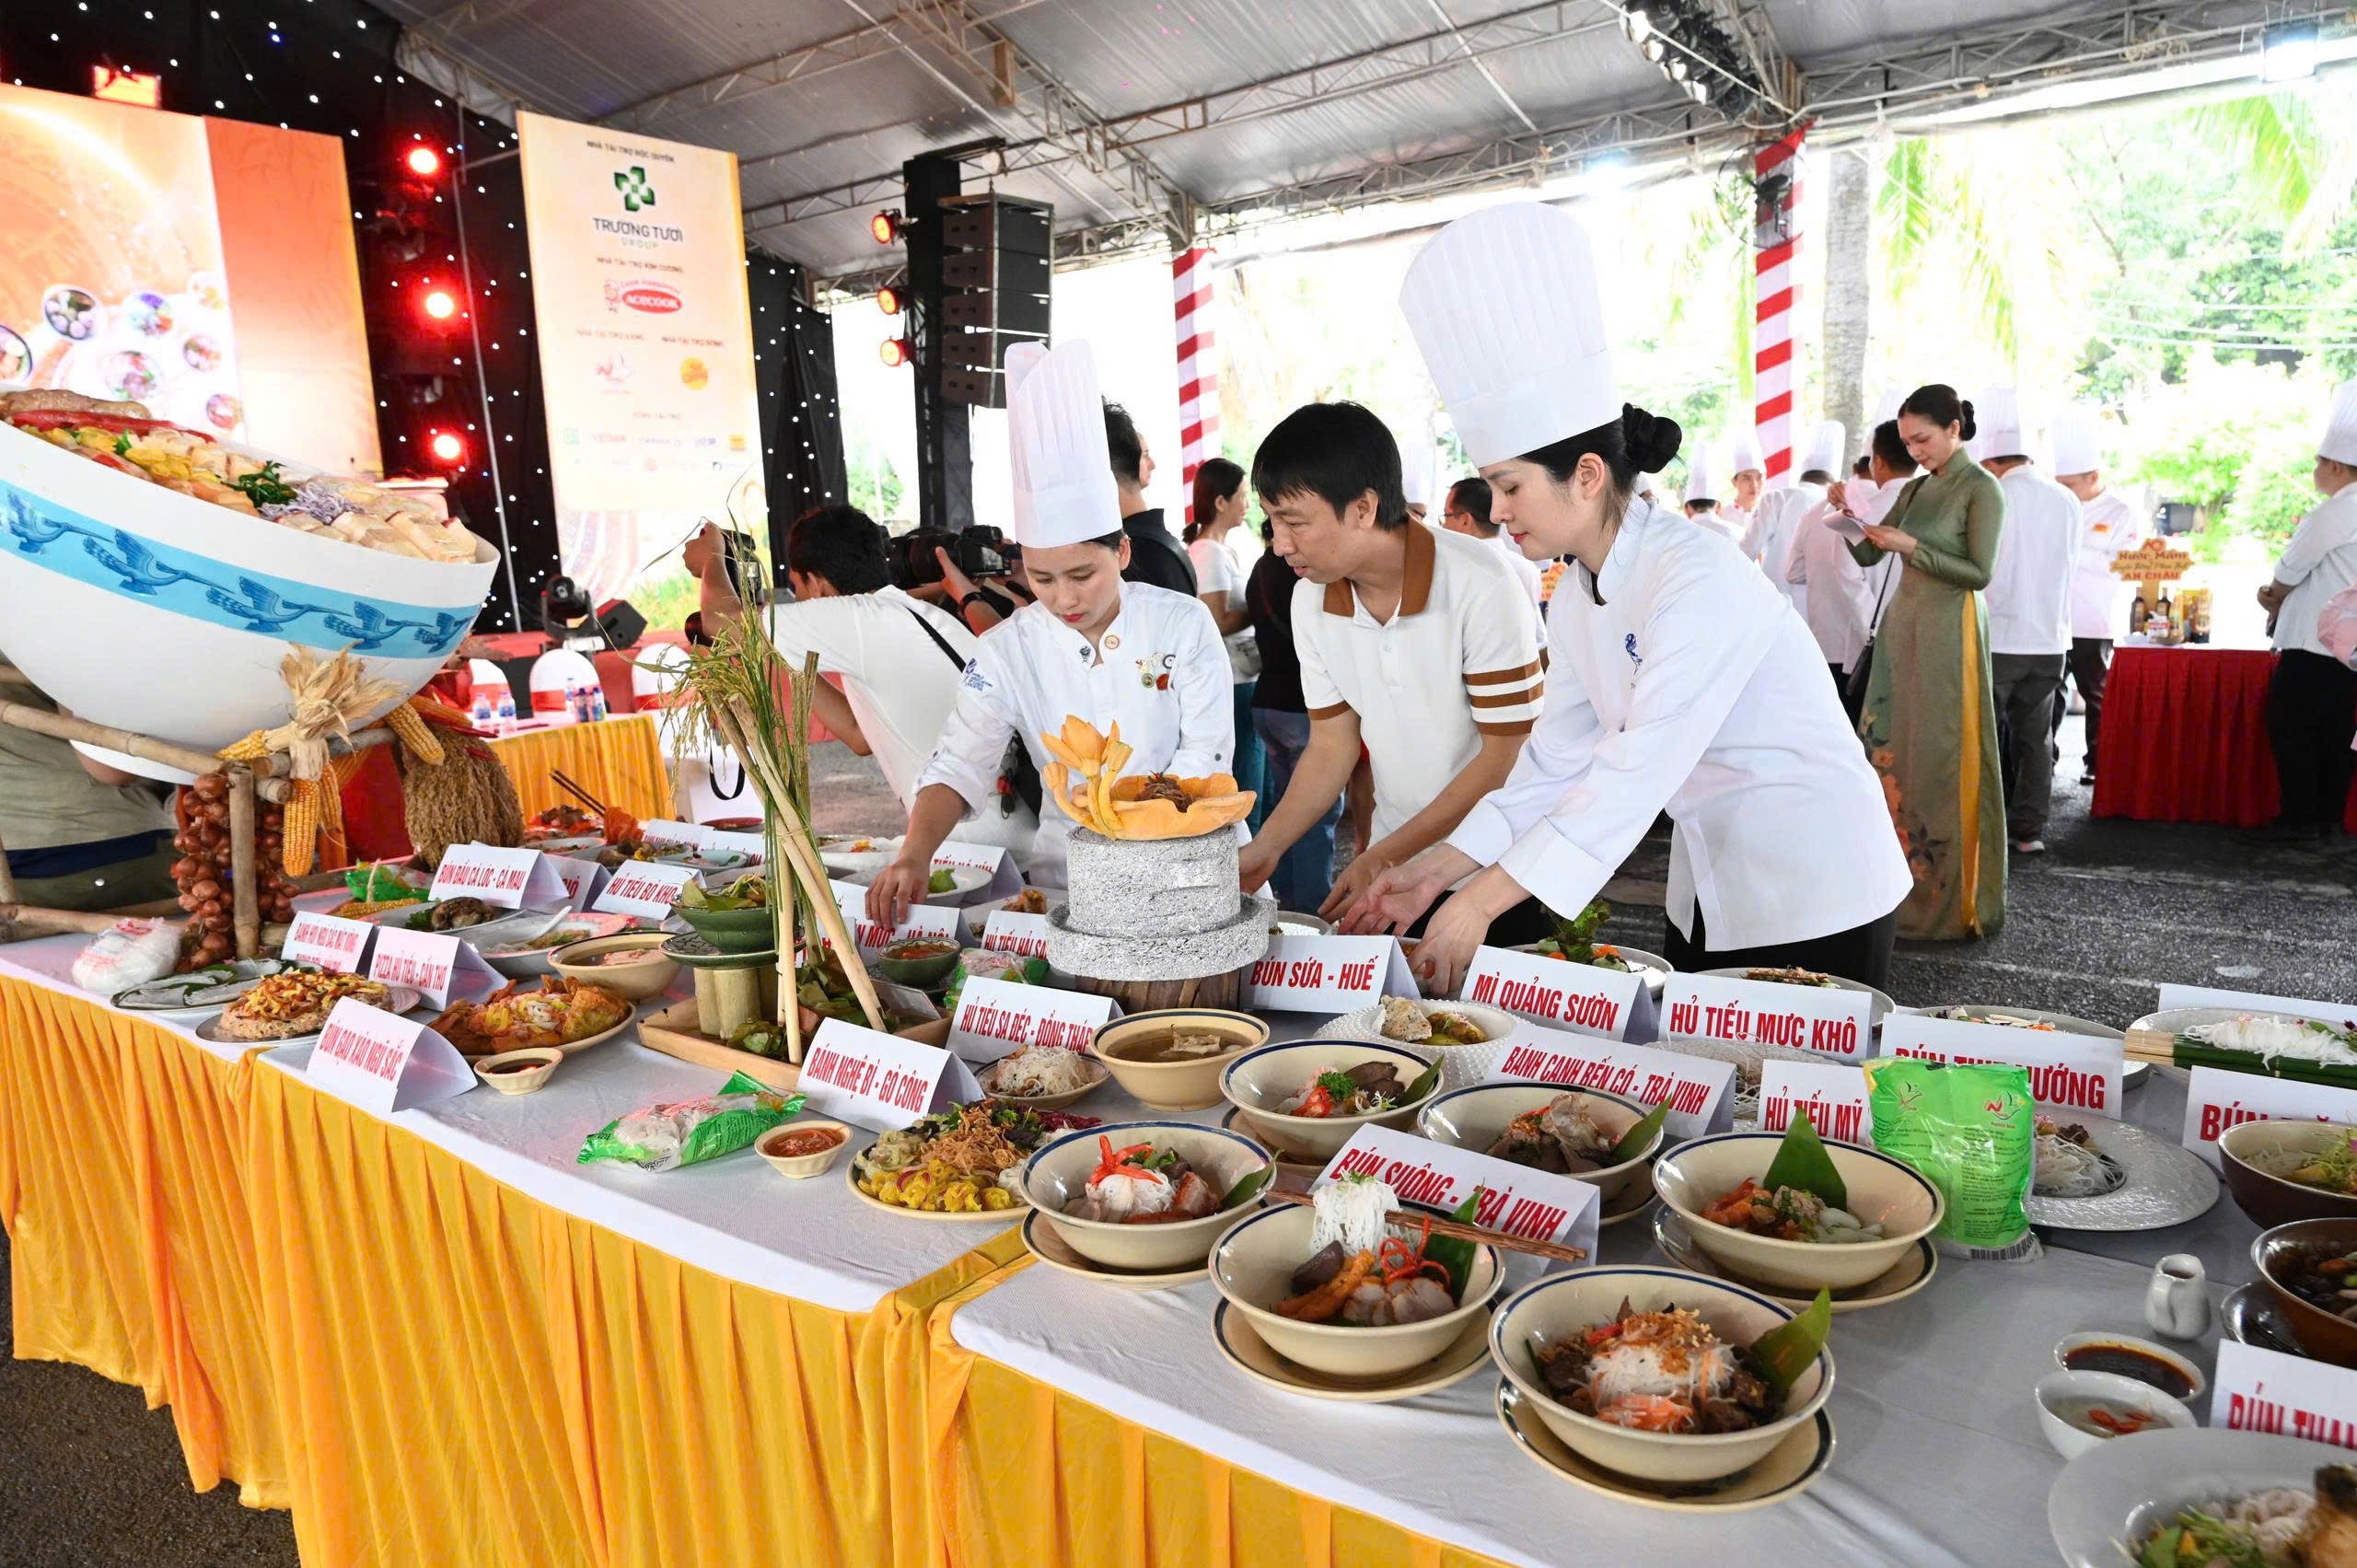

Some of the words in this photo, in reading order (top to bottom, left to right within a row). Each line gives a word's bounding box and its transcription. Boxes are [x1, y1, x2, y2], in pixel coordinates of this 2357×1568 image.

[1249, 956, 1288, 987] BÚN
[1288, 957, 1323, 989] SỨA
[1337, 955, 1379, 991] HUẾ
[1472, 971, 1500, 1004] MÌ
[1499, 976, 1562, 1019] QUẢNG
[1563, 993, 1620, 1031] SƯỜN
[959, 995, 981, 1033] HỦ
[974, 999, 999, 1037] TIẾU
[995, 1009, 1010, 1040] SA
[1670, 994, 1700, 1035] HỦ
[1705, 1000, 1750, 1040] TIẾU
[1811, 1016, 1856, 1054] KHÔ
[807, 1043, 841, 1084] BÁNH
[832, 1054, 868, 1099] NGHỆ
[878, 1063, 901, 1104] GÒ
[894, 1069, 928, 1113] CÔNG
[1501, 1042, 1548, 1078] BÁNH
[1539, 1054, 1585, 1085] CANH
[1580, 1055, 1614, 1090] BẾN
[1611, 1063, 1639, 1096] CÓ
[1639, 1071, 1675, 1106] TRÀ
[1669, 1080, 1711, 1115] VINH
[2016, 1063, 2106, 1109] ƯỚNG
[1764, 1086, 1788, 1132] HỦ
[1834, 1098, 1863, 1144] MỸ
[1329, 1146, 1387, 1179] BÚN
[1502, 1197, 1567, 1241] VINH
